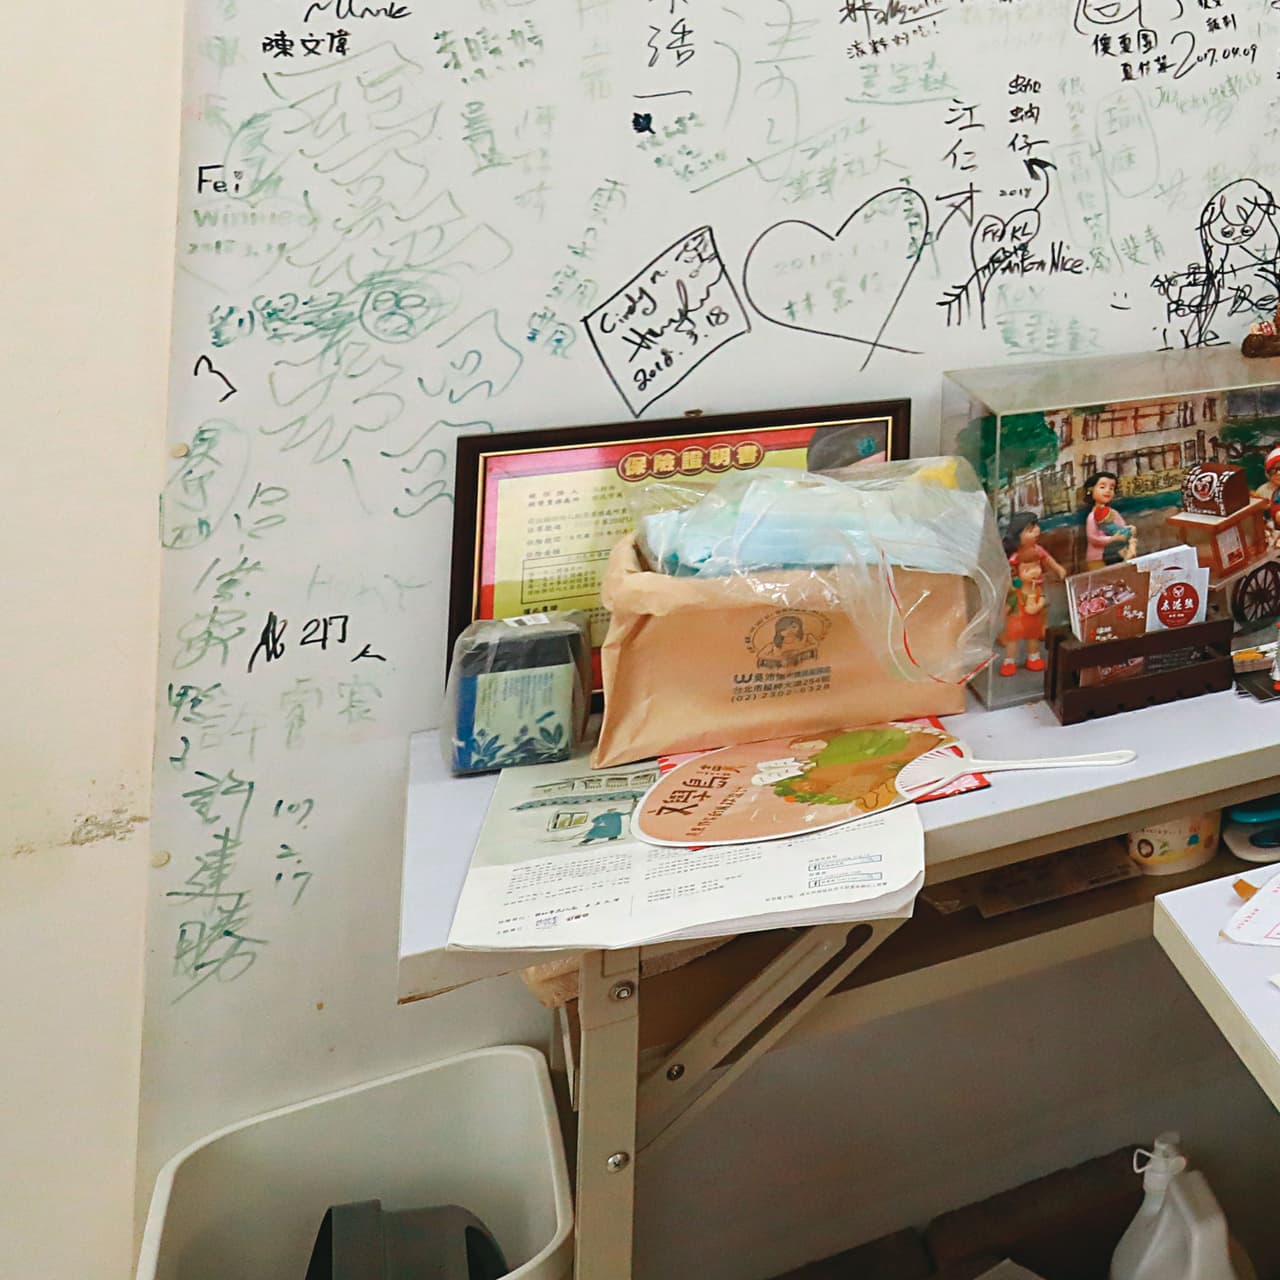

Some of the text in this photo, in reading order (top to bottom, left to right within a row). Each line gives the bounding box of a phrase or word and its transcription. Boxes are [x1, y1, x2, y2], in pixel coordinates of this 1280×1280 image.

[624, 444, 759, 477] 保險證明書
